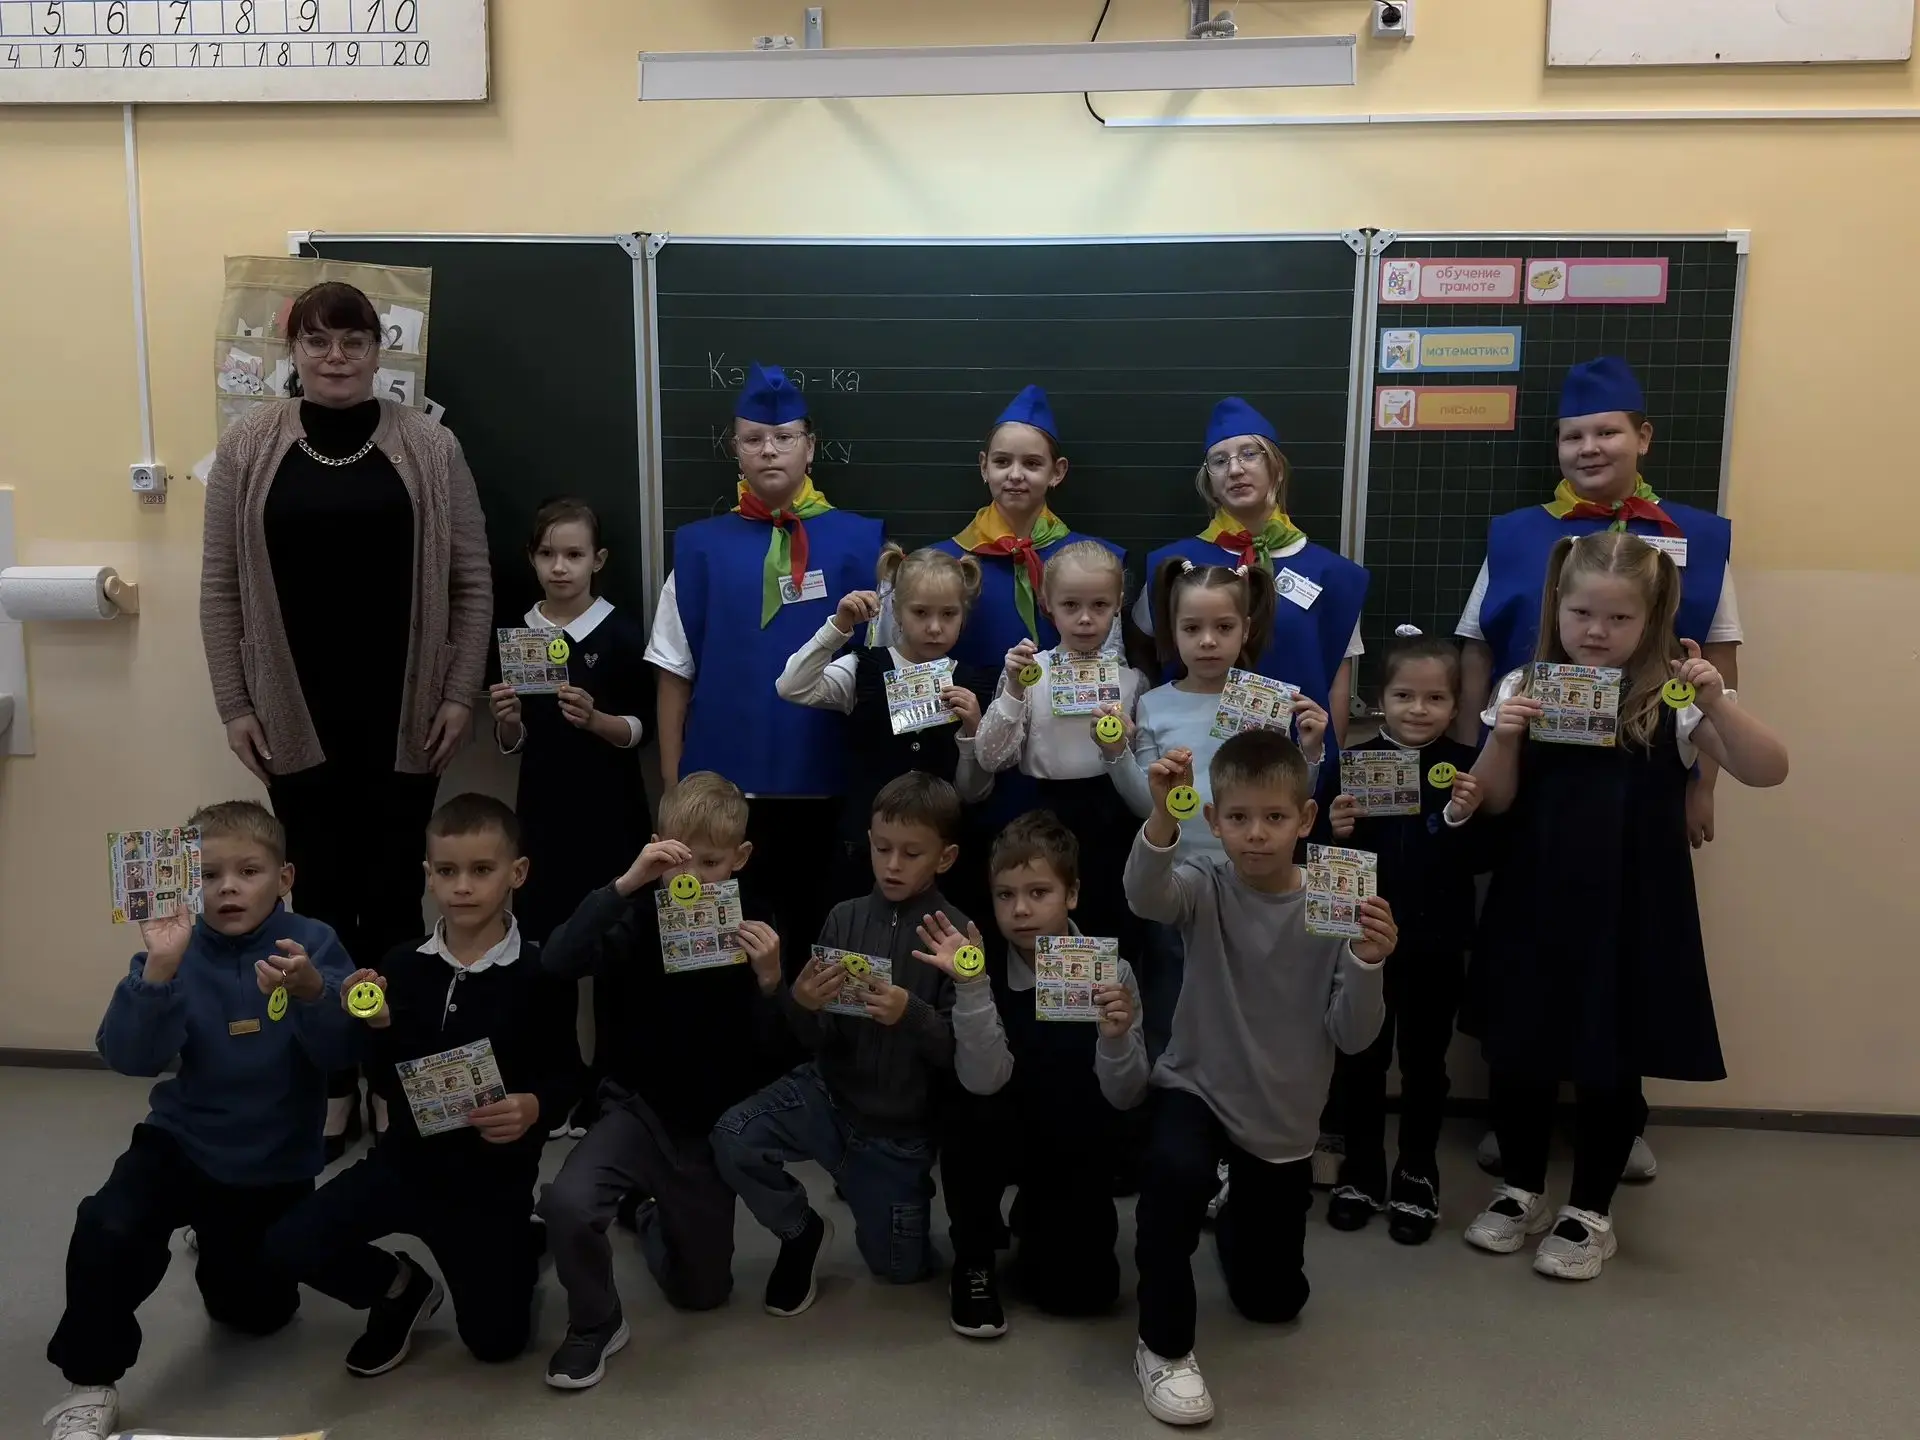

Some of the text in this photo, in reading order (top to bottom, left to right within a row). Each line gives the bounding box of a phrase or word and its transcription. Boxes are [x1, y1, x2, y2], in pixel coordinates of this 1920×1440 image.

[43, 1, 62, 35] 5
[106, 1, 125, 35] 6
[169, 1, 189, 35] 7
[235, 0, 253, 34] 8
[298, 0, 318, 33] 9
[1435, 267, 1502, 281] обучение
[1439, 282, 1497, 295] грамоте
[387, 324, 403, 351] 2
[1425, 344, 1510, 358] математика
[1439, 404, 1487, 416] письмо
